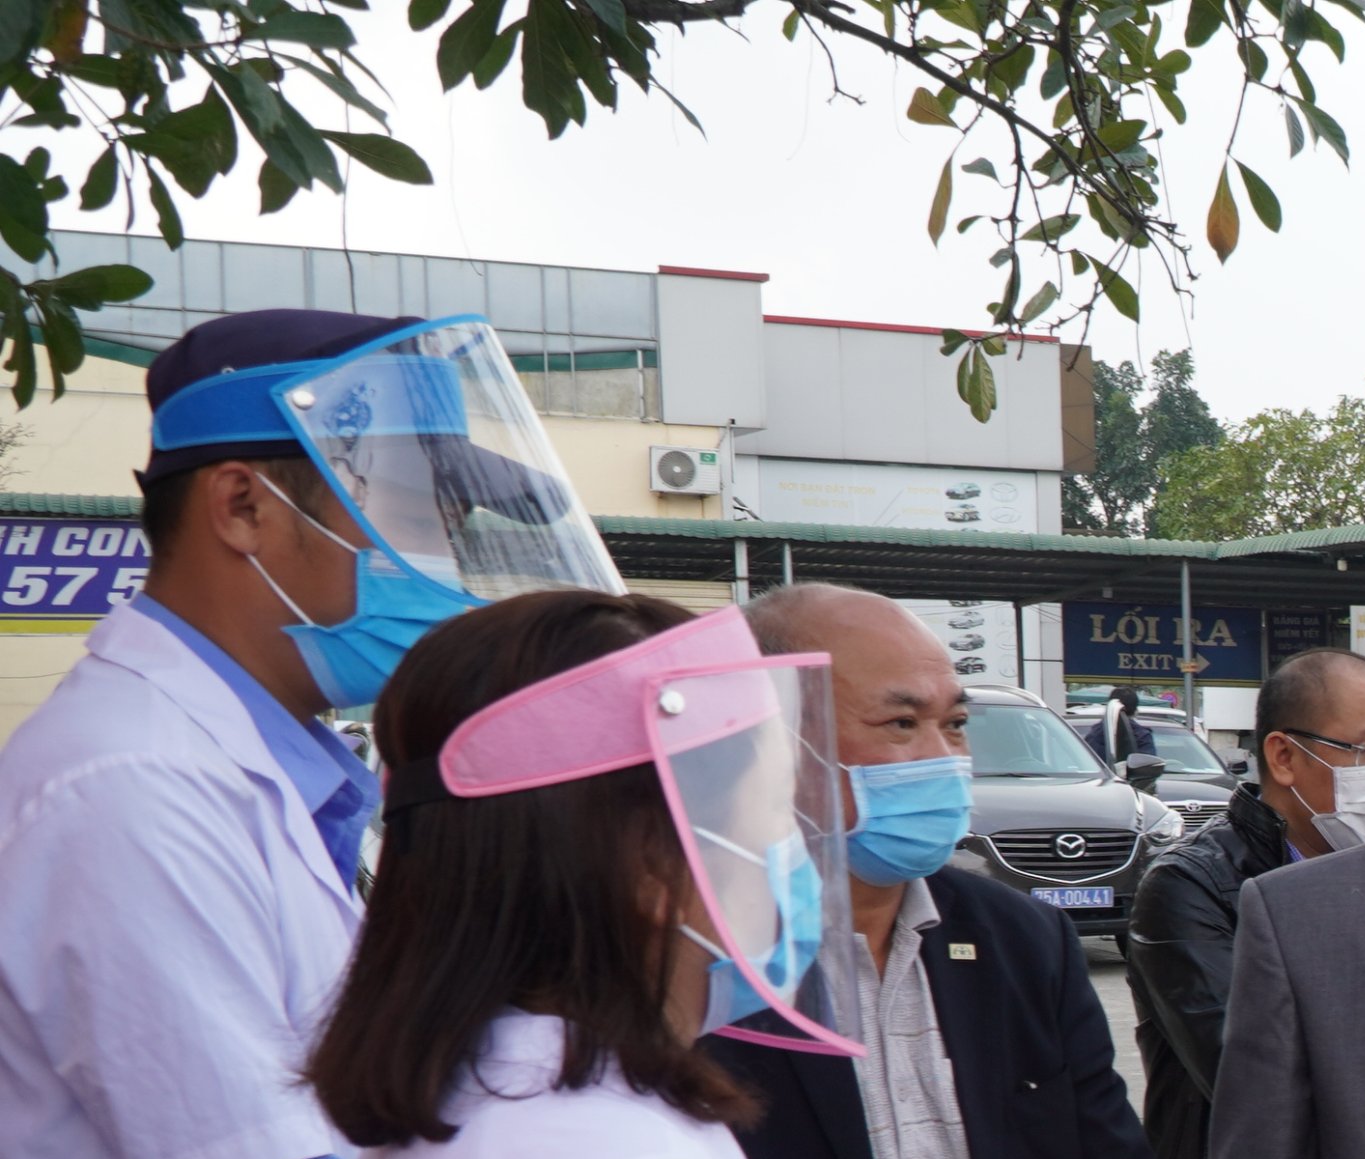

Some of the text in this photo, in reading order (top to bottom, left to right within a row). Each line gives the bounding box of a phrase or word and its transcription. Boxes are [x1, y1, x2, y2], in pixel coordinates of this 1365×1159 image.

[0, 525, 45, 555] H
[2, 566, 99, 606] 57
[1089, 606, 1237, 647] LỐI RA
[1117, 652, 1173, 671] EXIT
